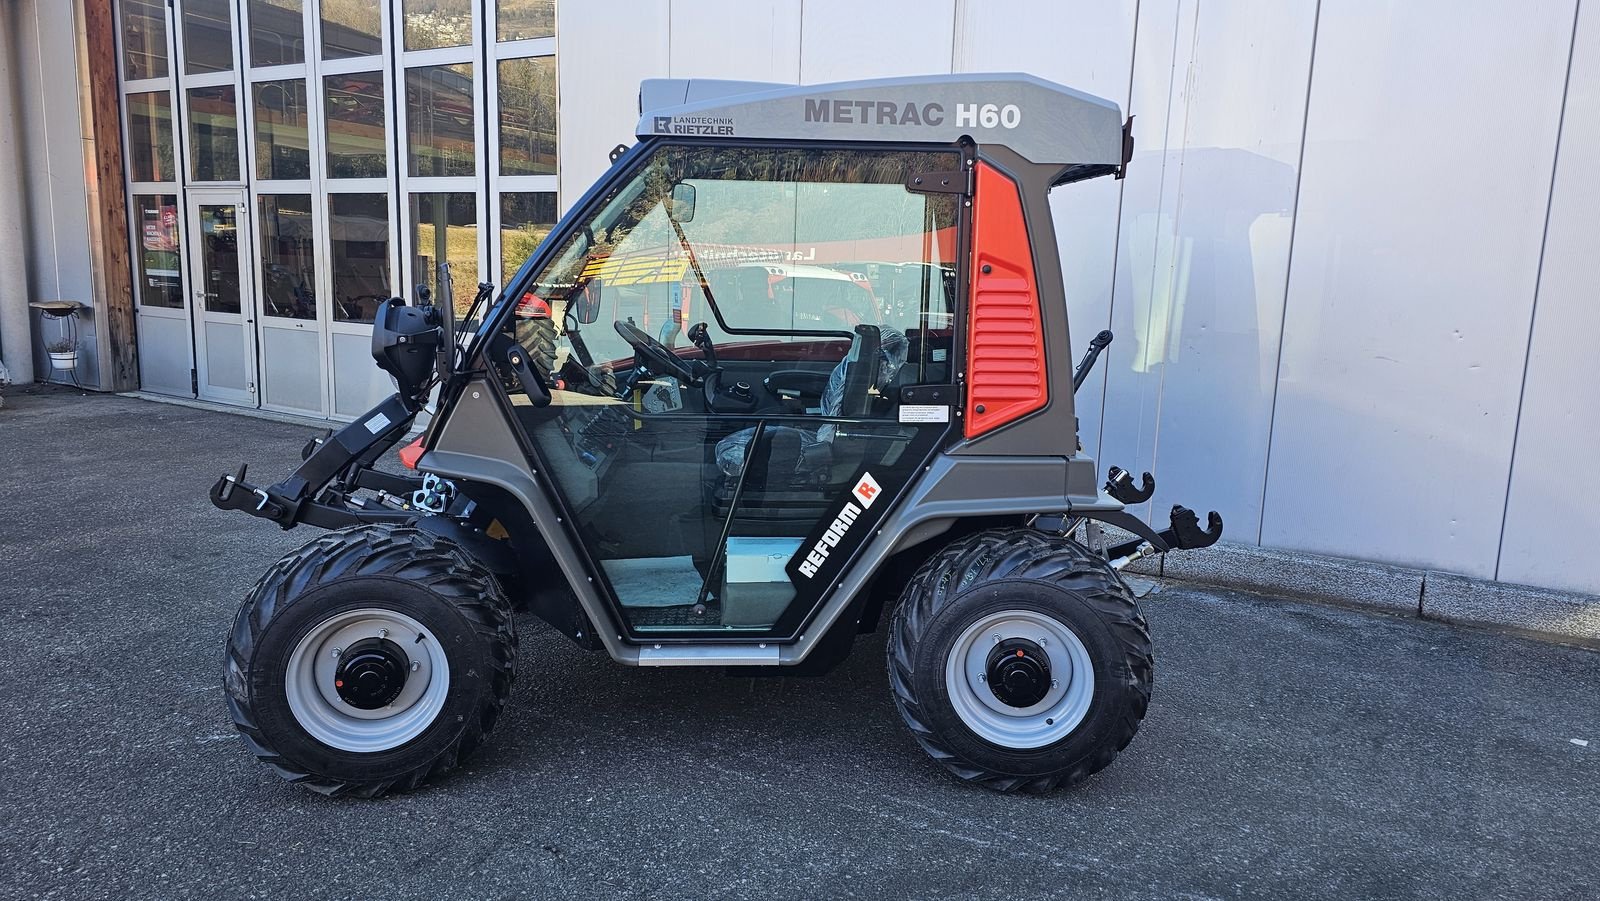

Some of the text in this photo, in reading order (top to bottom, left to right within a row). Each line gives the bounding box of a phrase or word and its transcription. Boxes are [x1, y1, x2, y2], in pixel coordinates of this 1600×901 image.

[674, 116, 734, 125] LANDTECHNIK
[804, 98, 1021, 129] METRAC H60
[674, 125, 735, 135] RIETZLER
[798, 481, 877, 579] REFORM R
